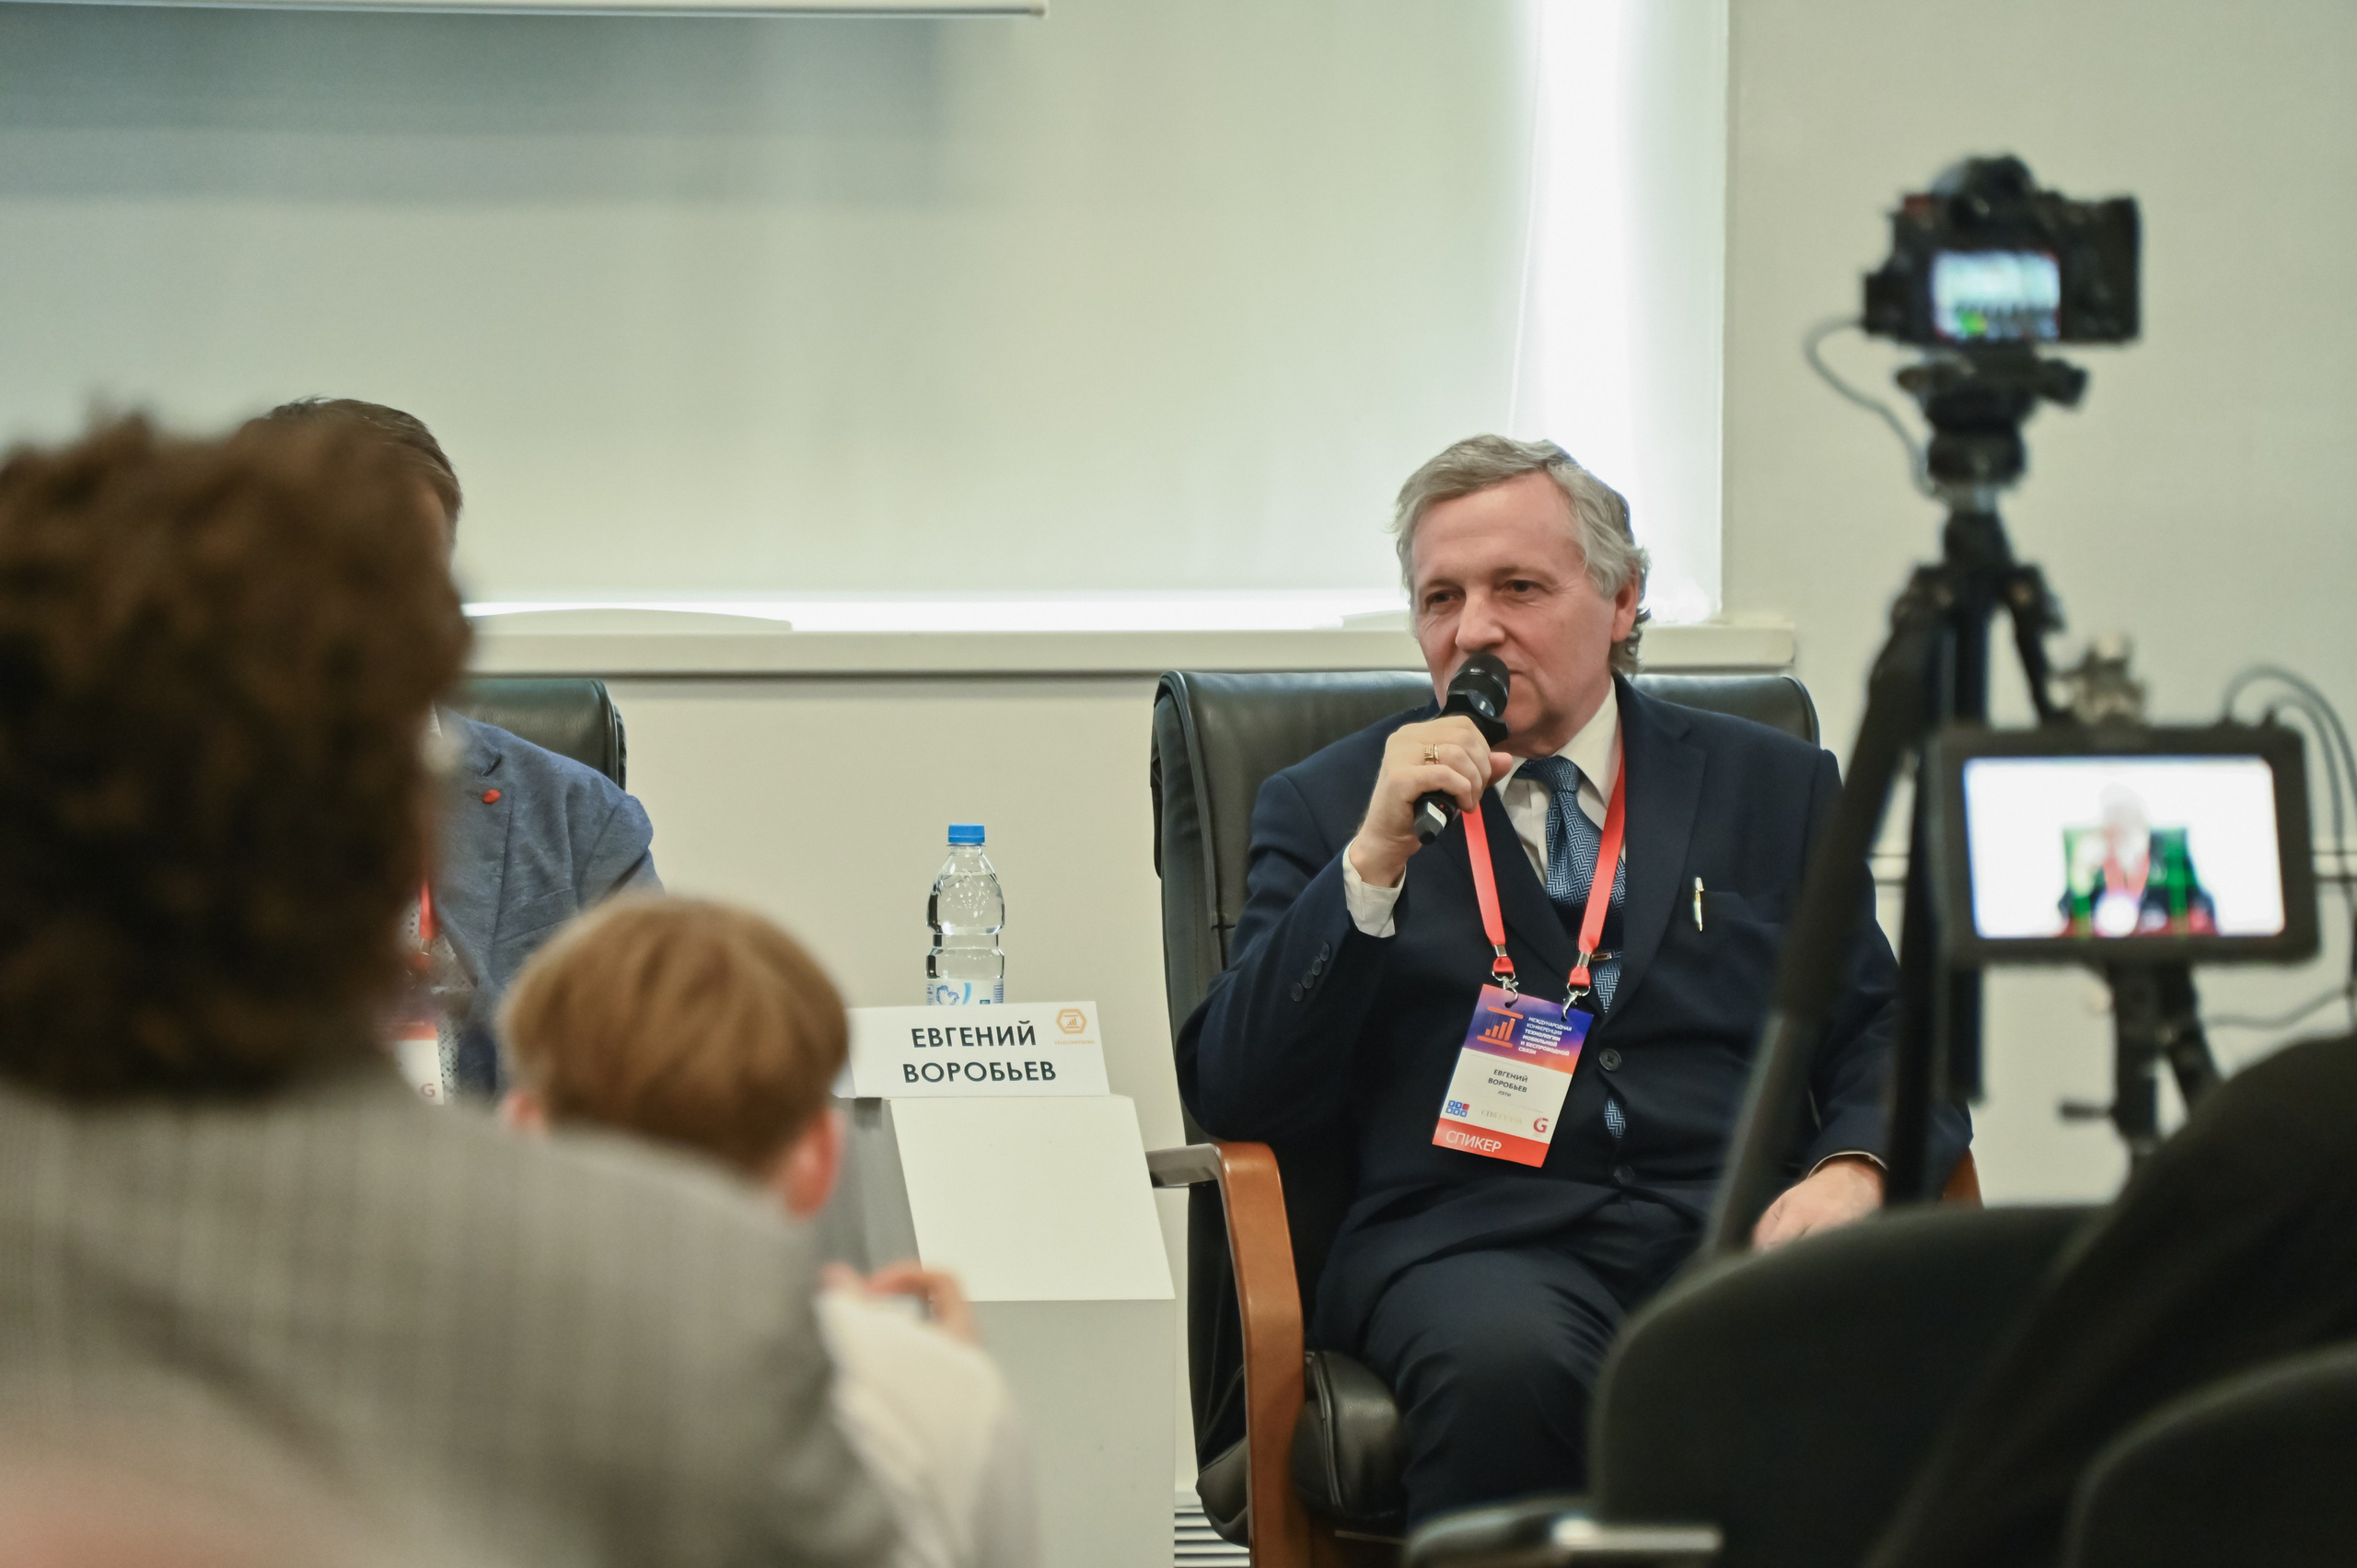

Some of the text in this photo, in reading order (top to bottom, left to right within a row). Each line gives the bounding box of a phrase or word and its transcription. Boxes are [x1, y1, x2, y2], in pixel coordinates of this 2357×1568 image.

[911, 1020, 1037, 1048] ЕВГЕНИЙ
[903, 1061, 1057, 1083] ВОРОБЬЕВ
[1493, 1069, 1528, 1083] ЕВГЕНИЙ
[1488, 1077, 1527, 1093] ВОРОБЬЕВ
[1446, 1131, 1502, 1153] СПИКЕР
